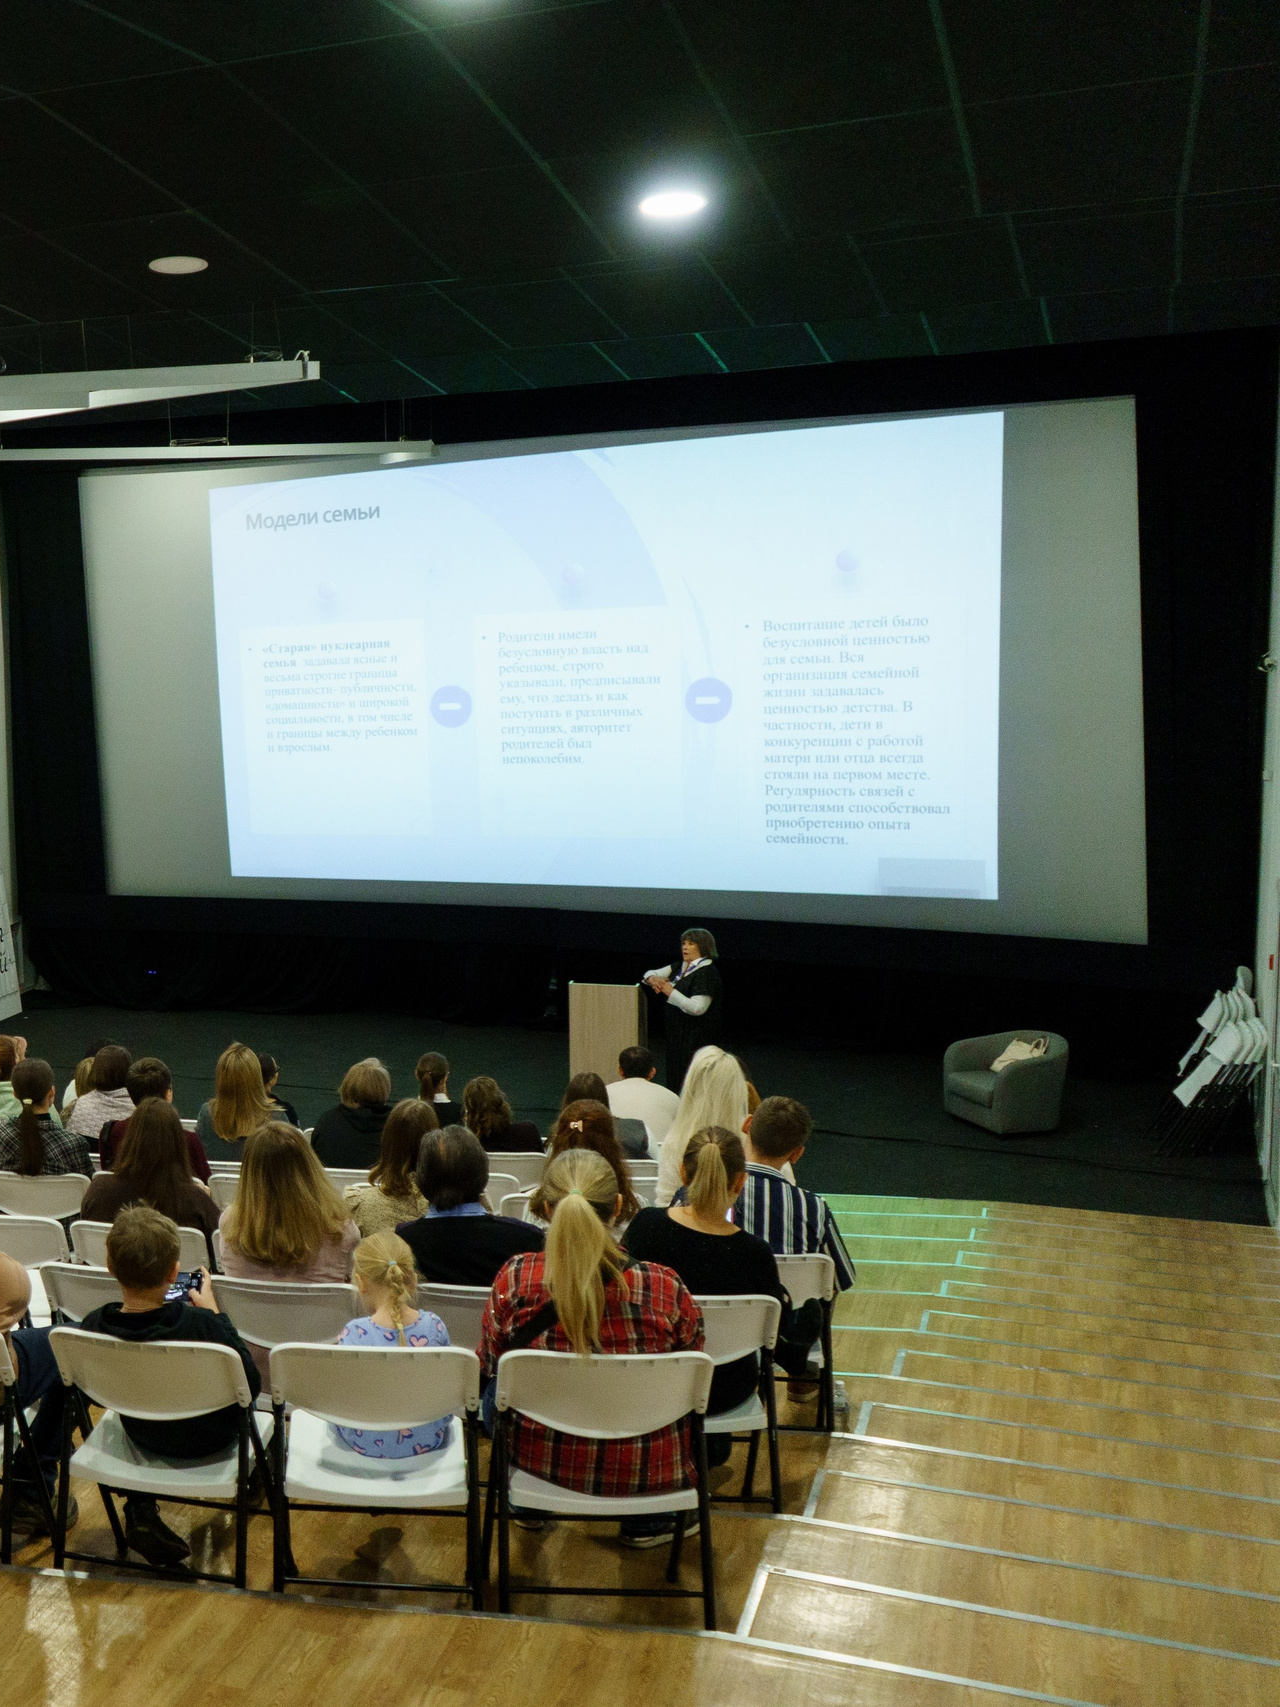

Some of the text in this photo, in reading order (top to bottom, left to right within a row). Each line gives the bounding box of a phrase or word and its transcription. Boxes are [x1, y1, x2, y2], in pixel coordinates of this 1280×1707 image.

[246, 506, 380, 531] Модели семьи
[763, 615, 929, 633] Воспитание детей было
[498, 630, 597, 643] Родители имели
[763, 634, 930, 650] безусловной ценностью
[391, 655, 397, 663] и
[498, 644, 649, 662] безусловную власть над
[763, 655, 786, 666] для
[840, 651, 864, 663] Вся
[563, 662, 604, 673] строго
[763, 666, 920, 683] организация семейной
[570, 675, 661, 689] предписывали
[528, 694, 548, 703] что
[552, 693, 592, 704] делать
[596, 693, 603, 701] и
[608, 692, 628, 701] как
[763, 686, 884, 698] жизни задавалась
[349, 700, 355, 708] и
[764, 703, 837, 716] ценностью
[903, 700, 913, 712] В
[348, 715, 353, 723] в
[501, 707, 643, 722] поступать в различных
[570, 723, 632, 736] авторитет
[840, 719, 871, 731] дети
[876, 720, 883, 730] в
[267, 731, 273, 739] и
[268, 744, 273, 753] и
[501, 738, 591, 752] родителей был
[764, 734, 923, 750] конкуренции с работой
[764, 754, 923, 765] матери или отца всегда
[765, 770, 809, 780] стояли
[814, 770, 828, 780] на
[834, 770, 882, 783] первом
[765, 784, 915, 799] Регулярность связей с
[766, 803, 950, 815] родителями способствовал
[766, 817, 910, 831] приобретению опыта
